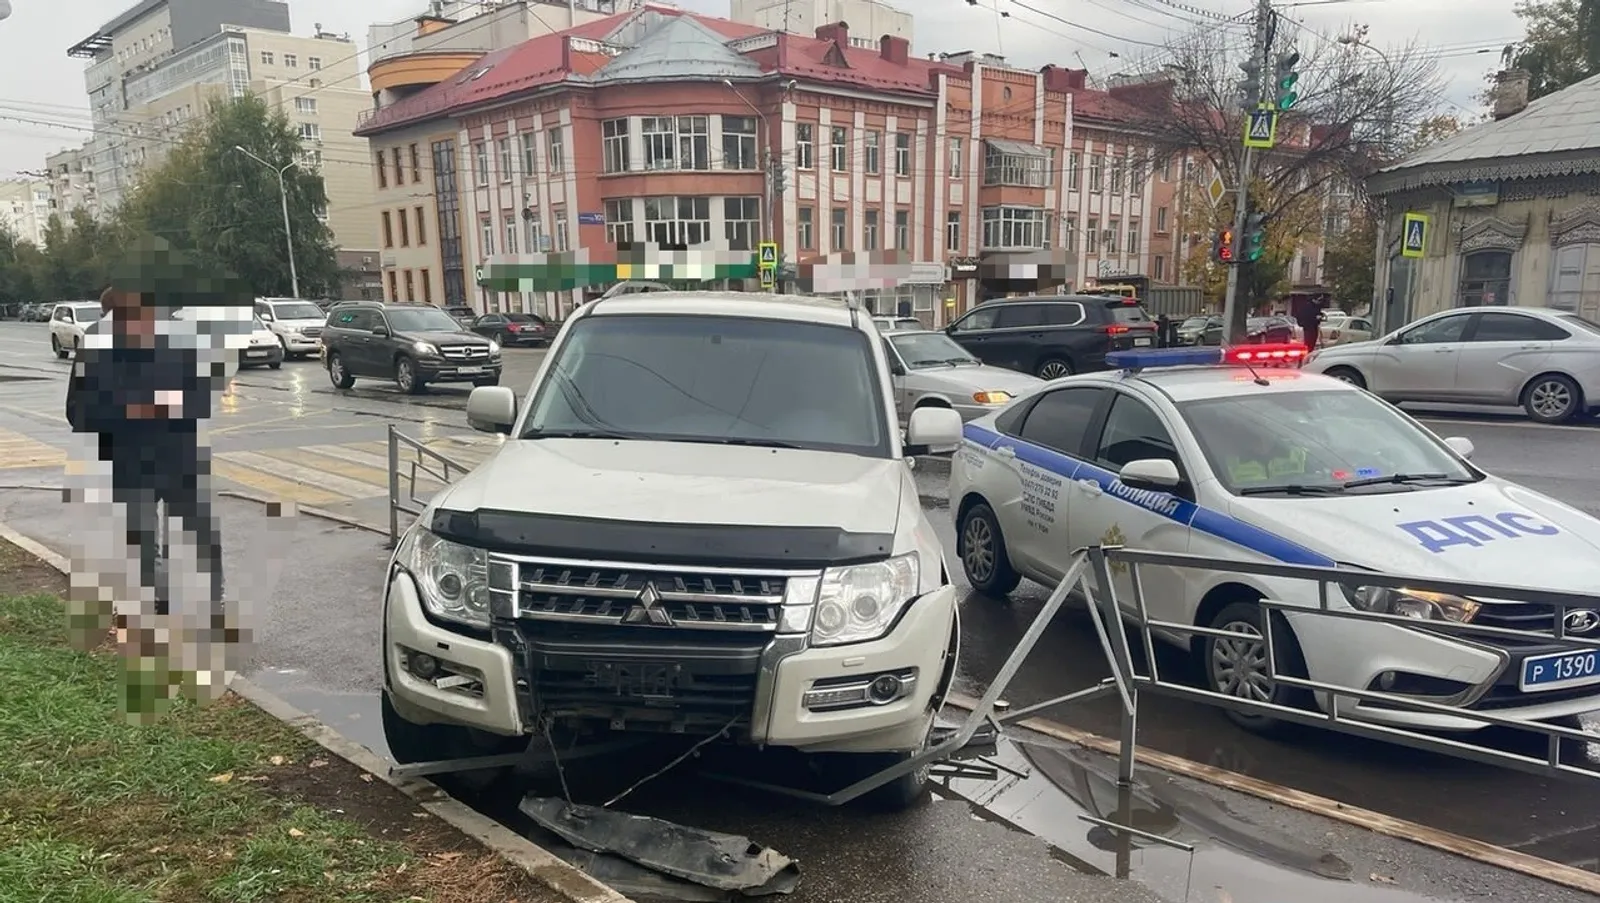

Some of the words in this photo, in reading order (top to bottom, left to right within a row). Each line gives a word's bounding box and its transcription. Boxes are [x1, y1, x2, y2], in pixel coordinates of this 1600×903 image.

[1108, 479, 1180, 515] ПОЛИЦИЯ
[1395, 512, 1559, 553] ДПС
[1554, 654, 1595, 678] 1390
